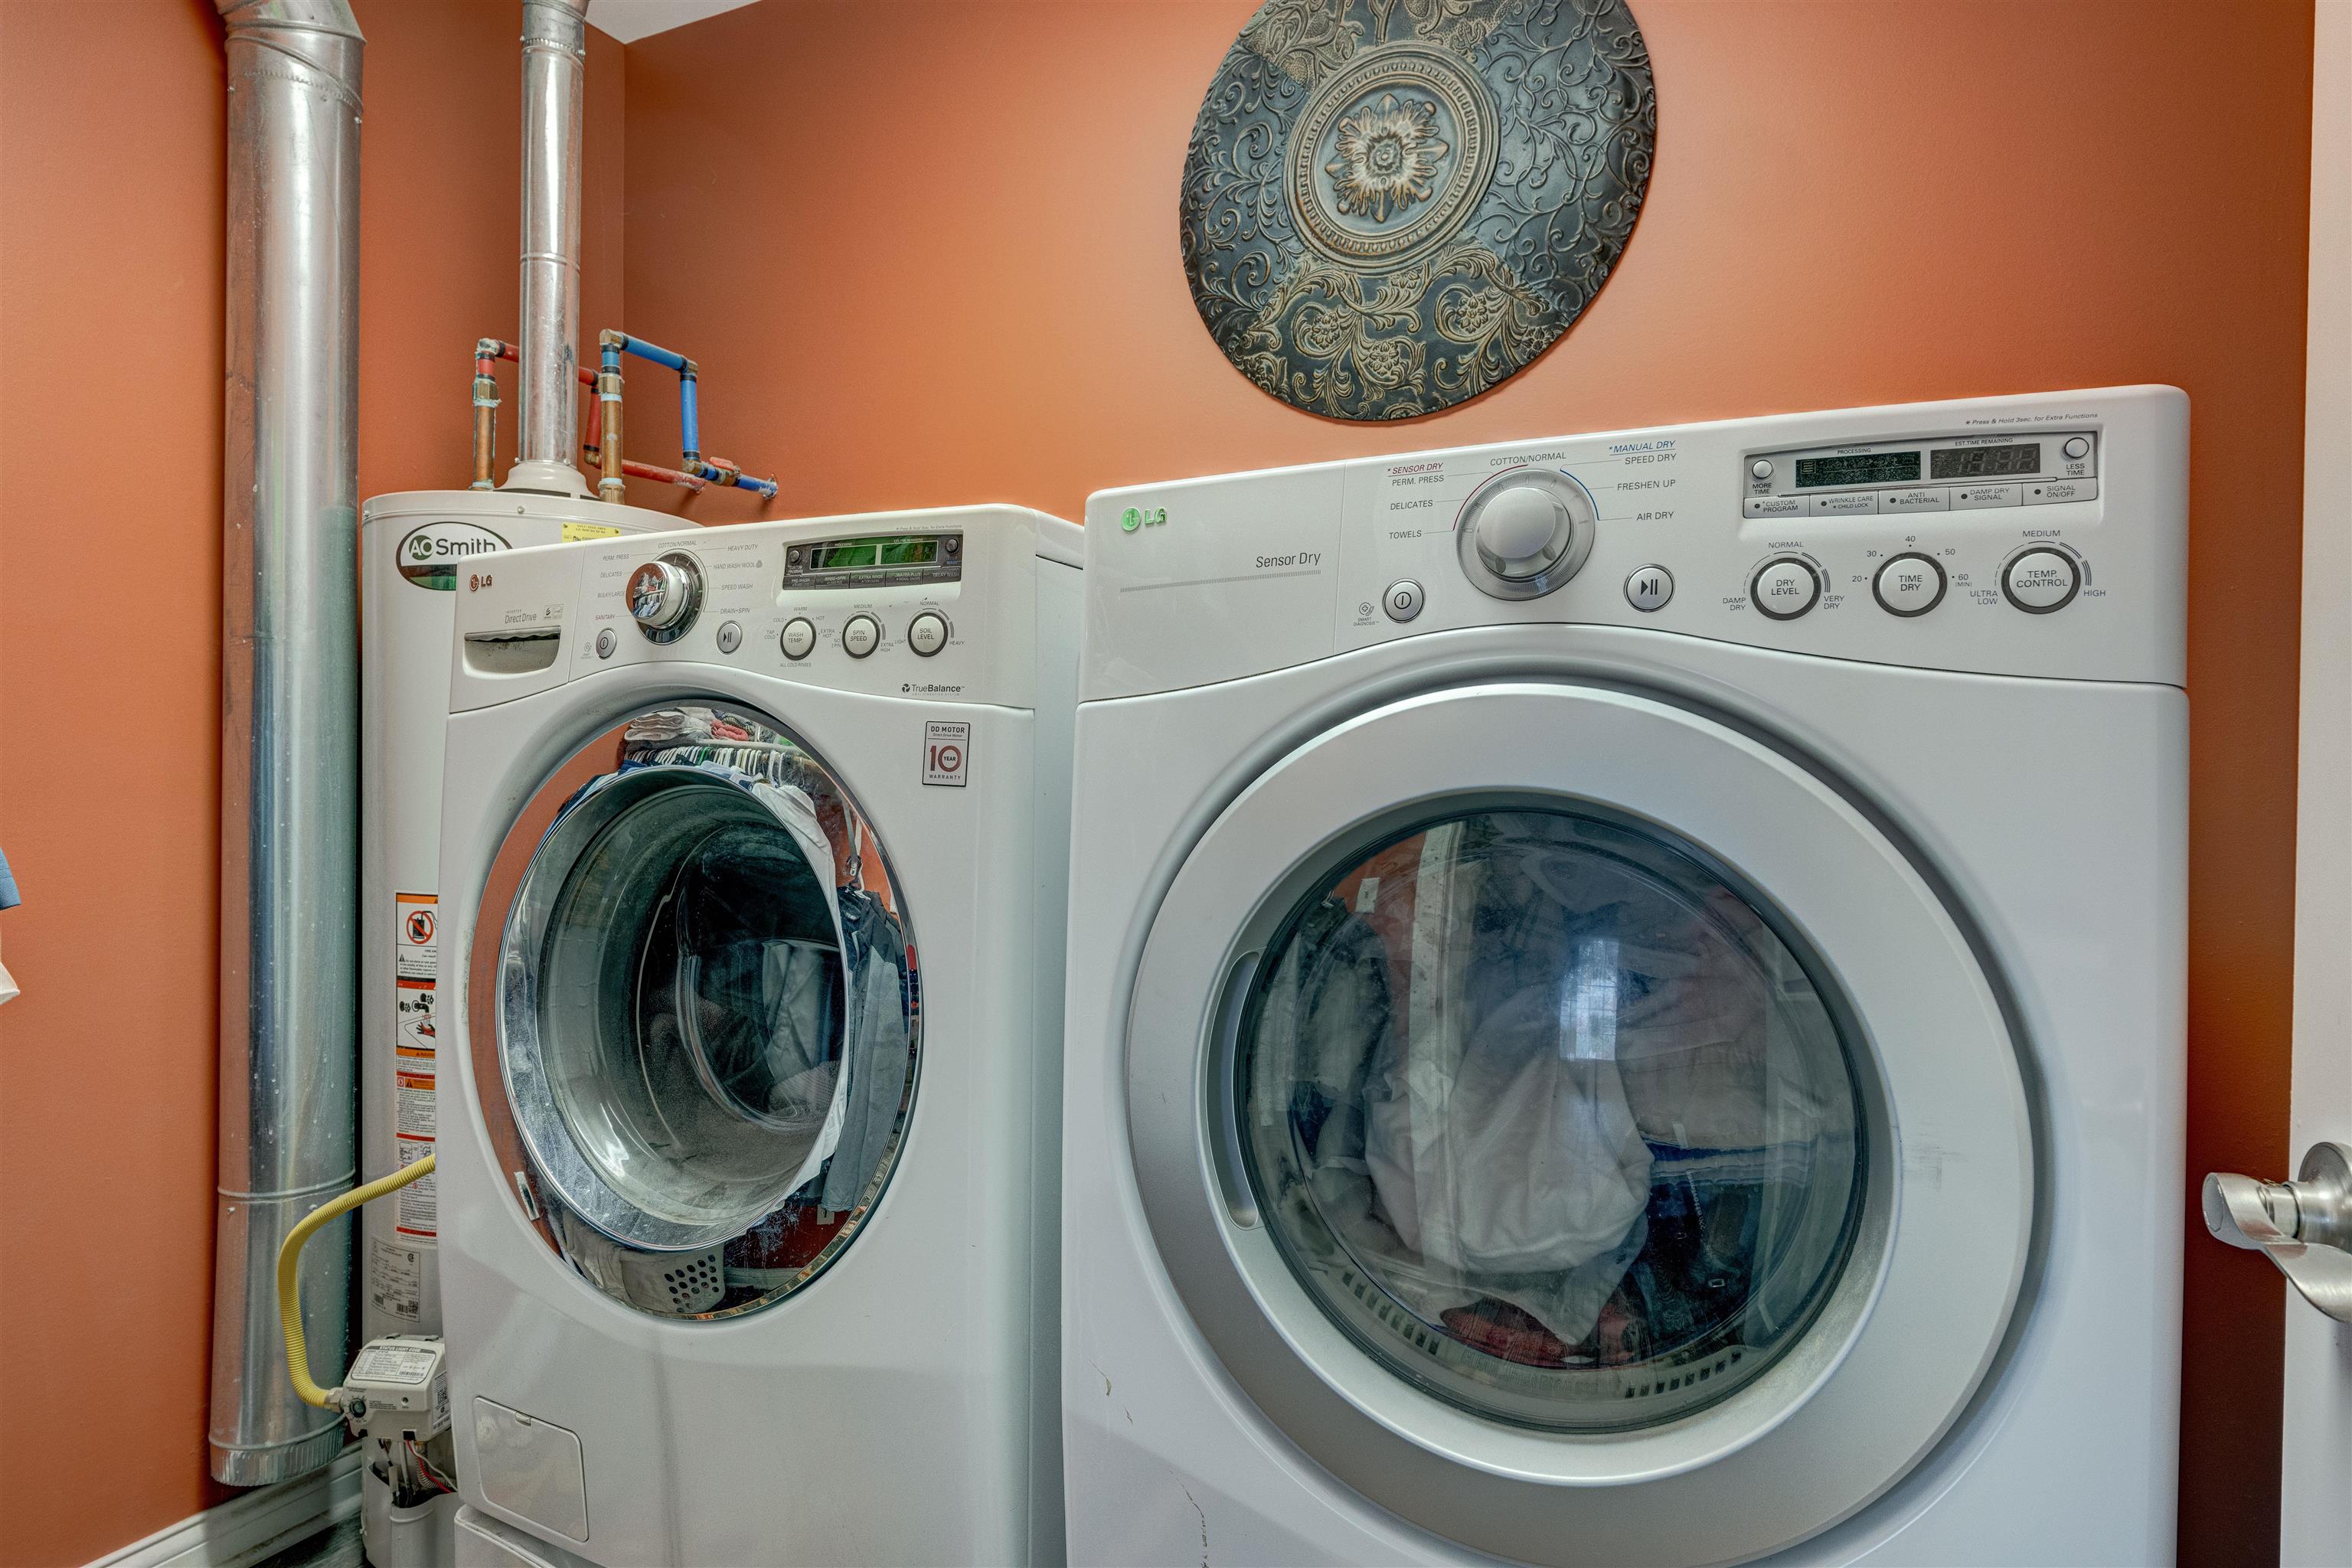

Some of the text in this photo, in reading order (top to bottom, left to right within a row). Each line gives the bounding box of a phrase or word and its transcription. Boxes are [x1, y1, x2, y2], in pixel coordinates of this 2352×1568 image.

[1613, 440, 1676, 453] MANUAL DRY
[1490, 452, 1566, 466] COTTON/NORMAL
[1625, 453, 1677, 465] SPEED DRY
[1392, 462, 1443, 474] SENSOR DRY
[1392, 475, 1444, 486] PERM. PRESS
[1617, 479, 1676, 491] FRESHEN UP
[1390, 500, 1433, 511] DELICATES
[1145, 507, 1167, 525] LG
[1636, 511, 1674, 521] AIR DRY
[1389, 530, 1422, 540] TOWELS
[409, 538, 496, 556] AO Smith
[1256, 552, 1321, 569] Sensor Dry
[2027, 570, 2057, 578] TEMP.
[481, 575, 492, 587] LG
[1775, 579, 1795, 587] DRY
[2016, 579, 2068, 589] CONTROL
[1771, 587, 1799, 596] LEVEL
[505, 612, 537, 624] Direct Drive
[929, 745, 962, 773] 10
